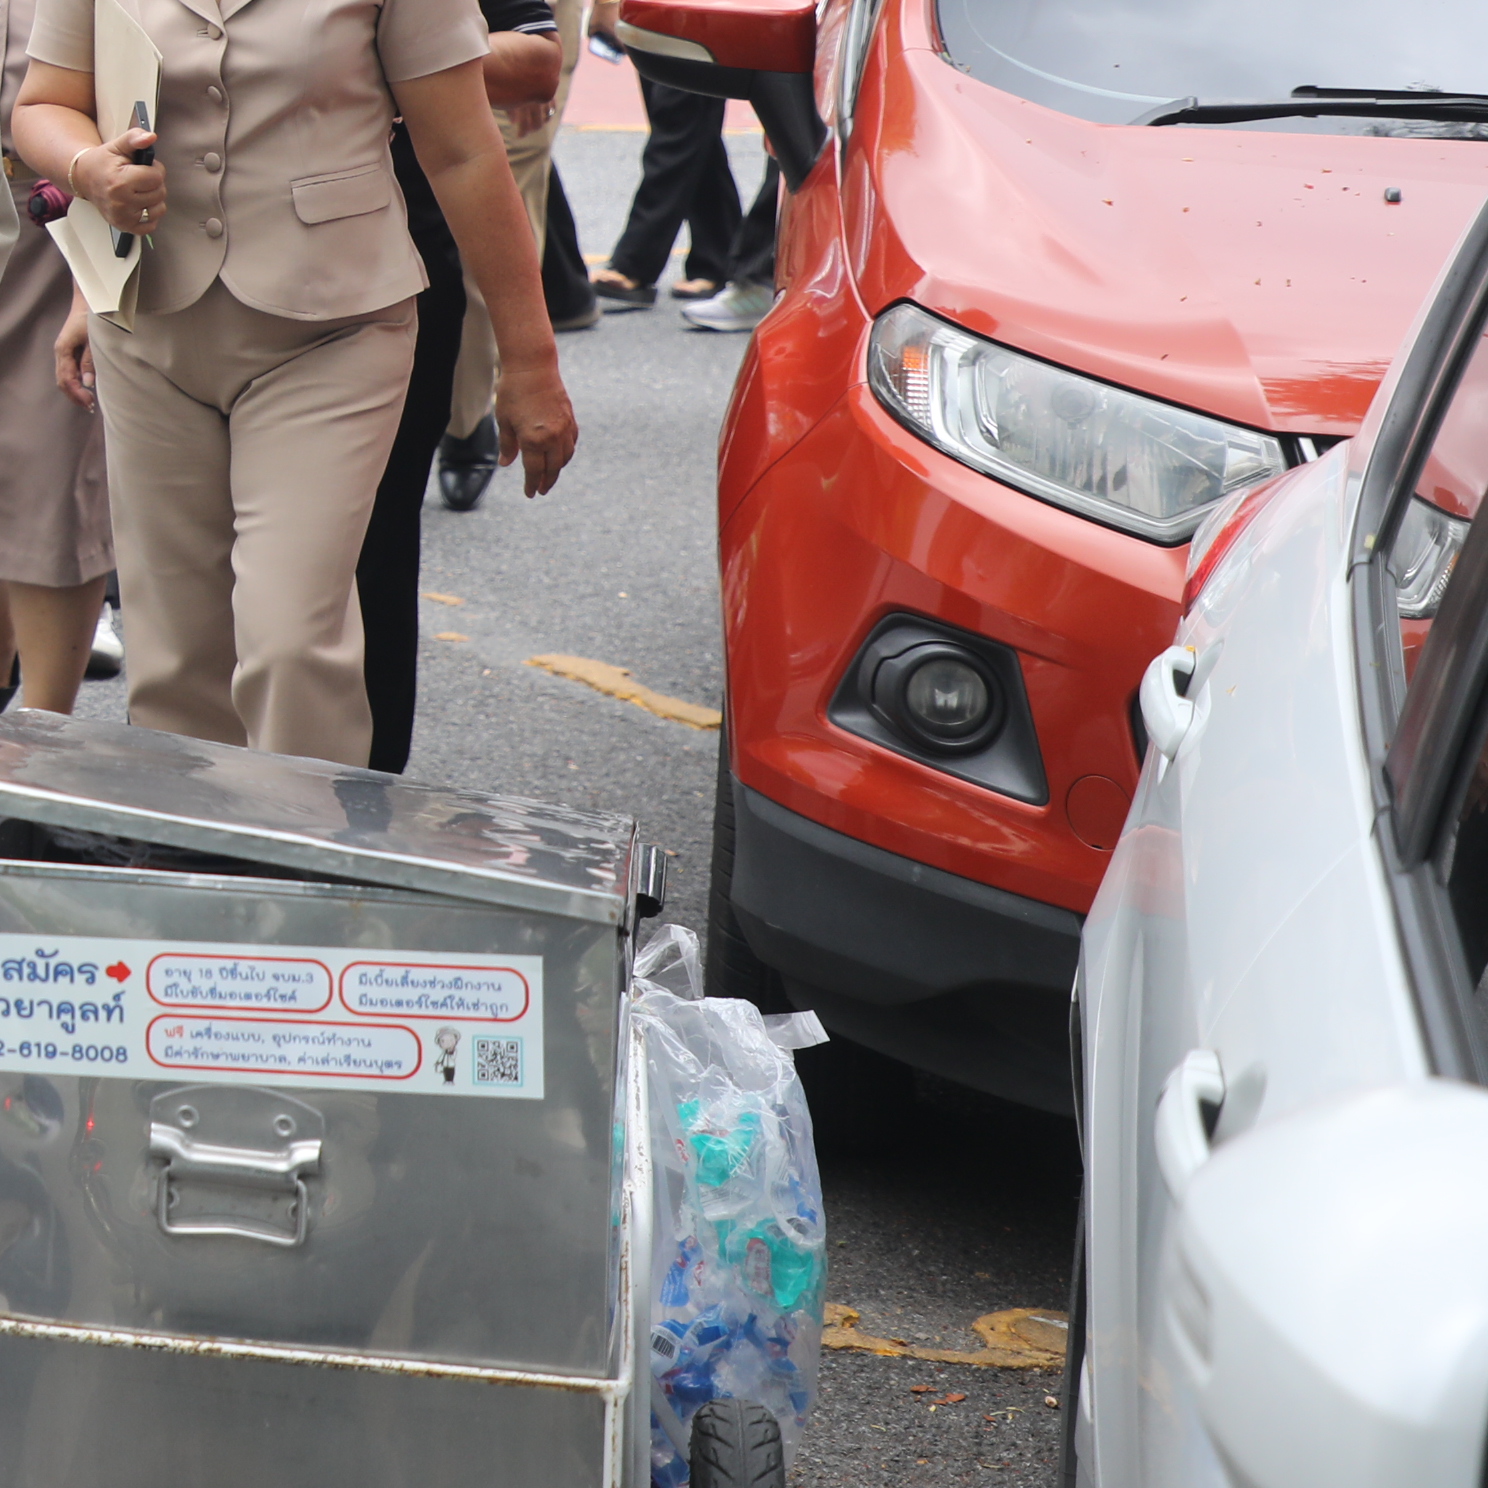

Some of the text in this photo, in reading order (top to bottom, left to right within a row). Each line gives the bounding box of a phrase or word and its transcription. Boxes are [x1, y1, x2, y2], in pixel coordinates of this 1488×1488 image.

[164, 967, 193, 984] อายุ
[198, 967, 213, 979] 18
[219, 962, 266, 982] ปีขึ้นไป
[358, 969, 502, 992] มีเบี้ยเลี้ยงช่วงฝึกงาน
[358, 993, 509, 1018] มีมอเตอร์ไซค์ให้เช่าถูก
[164, 1022, 372, 1049] ฟรี เครื่องแบบ, อุปกรณ์ทำงาน
[164, 1045, 403, 1074] มีค่ารักษาพยาบาล, ค่าเล่าเรียนบุตร
